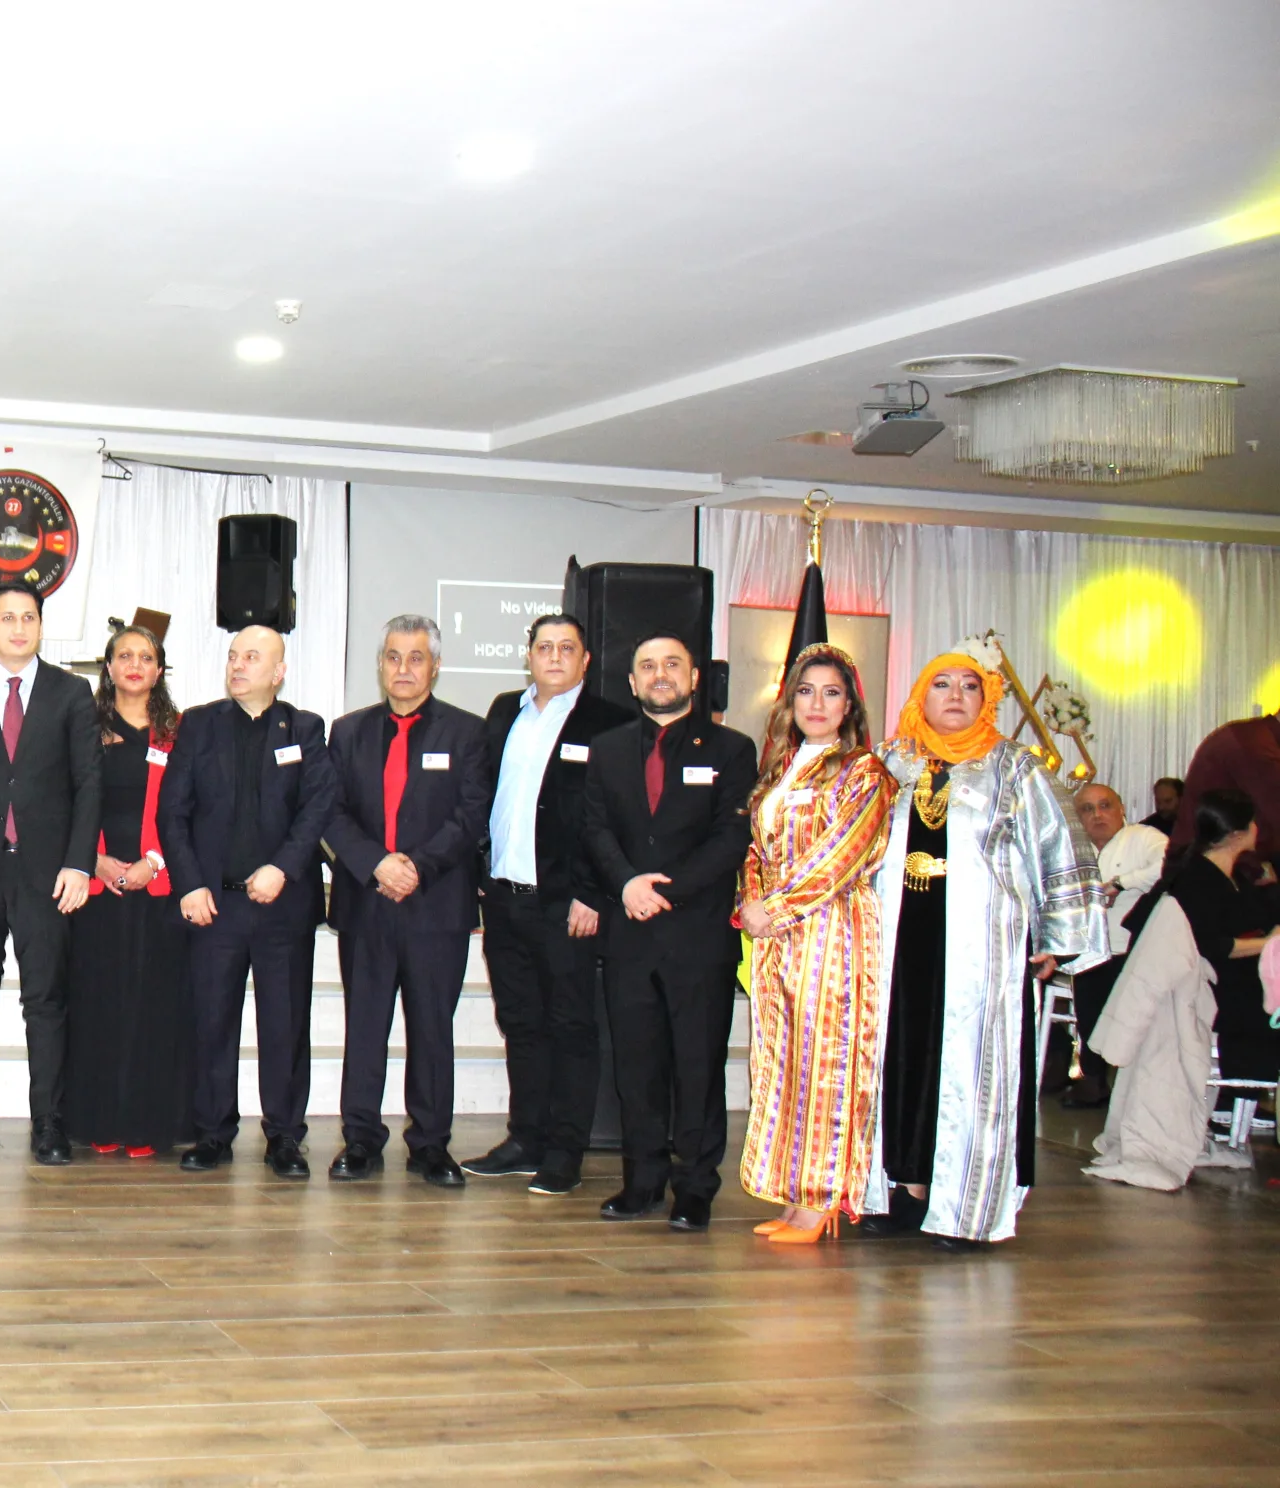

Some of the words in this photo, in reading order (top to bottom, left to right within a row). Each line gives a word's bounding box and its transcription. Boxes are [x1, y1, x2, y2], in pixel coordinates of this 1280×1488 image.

[7, 502, 20, 513] 27
[500, 600, 520, 615] No
[524, 602, 563, 616] Video
[474, 643, 513, 657] HDCP
